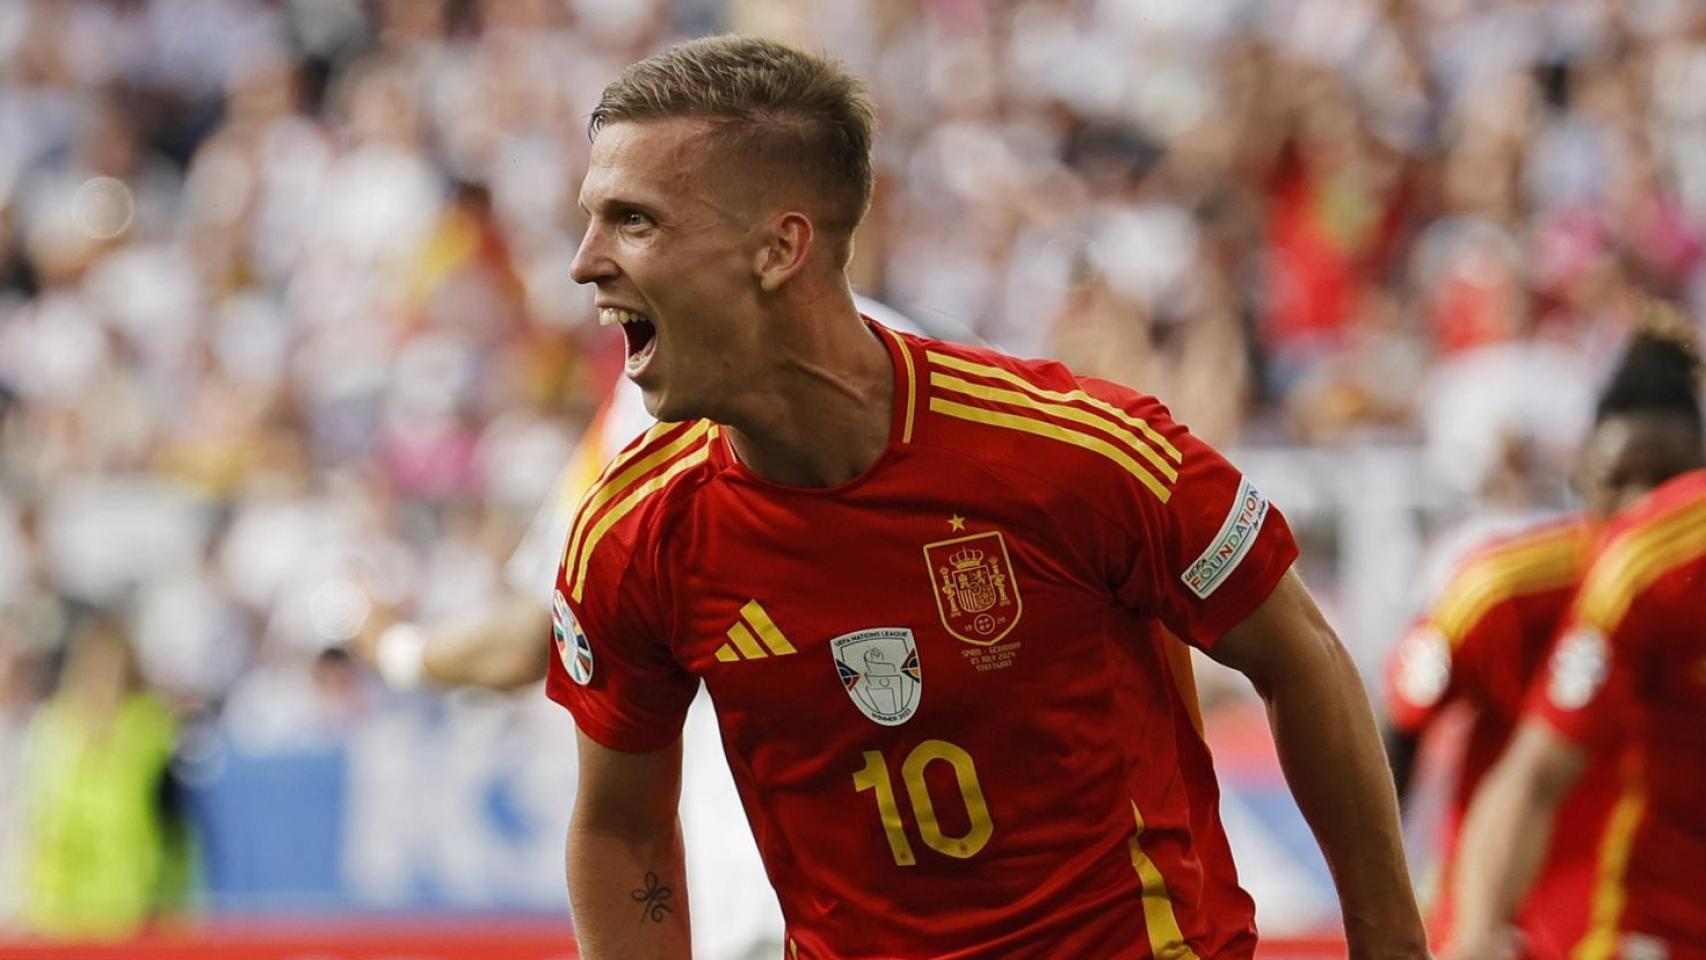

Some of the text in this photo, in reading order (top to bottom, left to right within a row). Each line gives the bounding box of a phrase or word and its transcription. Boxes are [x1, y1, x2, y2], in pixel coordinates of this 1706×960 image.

[1185, 559, 1207, 581] UEFA
[1190, 489, 1259, 590] FOUNDATION
[834, 630, 908, 647] UEFA NATIONS LEAGUE
[852, 739, 994, 867] 10
